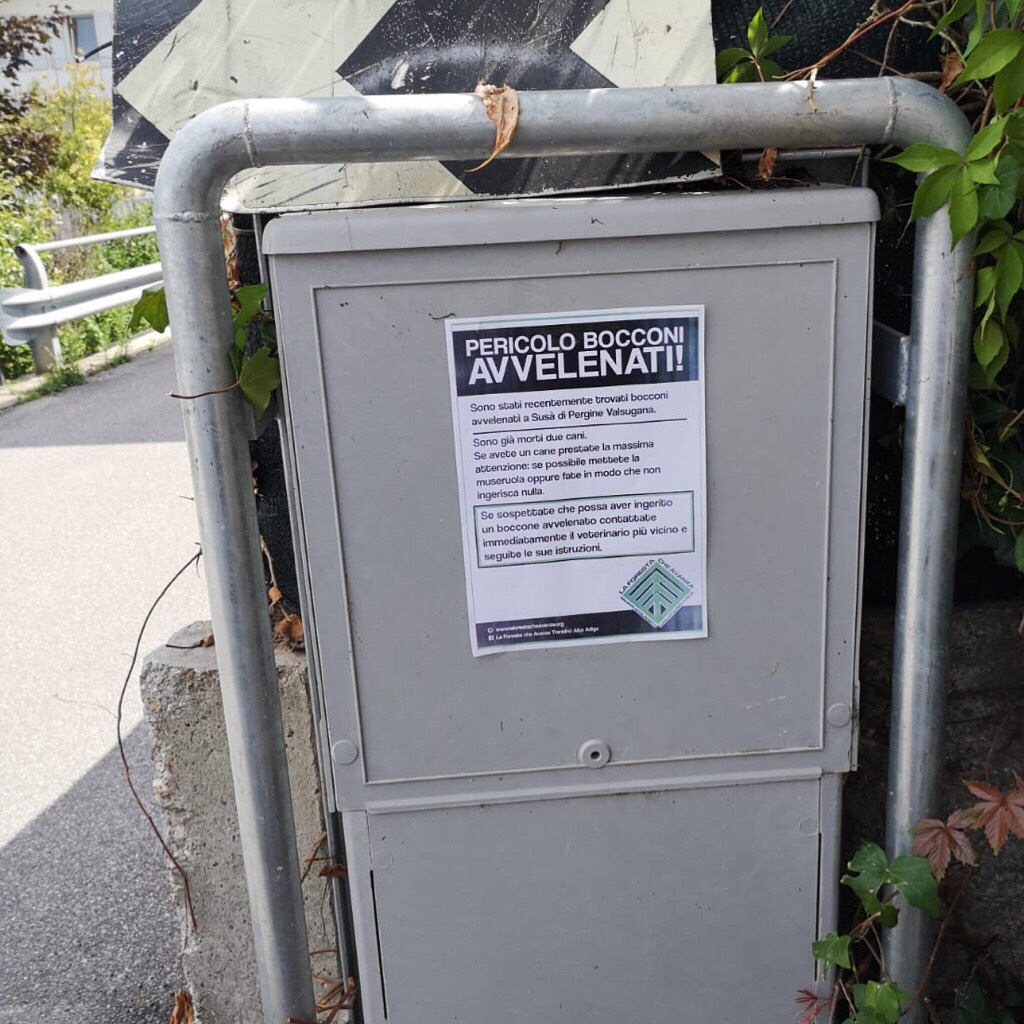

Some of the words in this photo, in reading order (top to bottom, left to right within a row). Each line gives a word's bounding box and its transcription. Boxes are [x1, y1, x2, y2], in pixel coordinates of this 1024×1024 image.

[465, 332, 576, 357] PERICOLO
[583, 326, 684, 349] BOCCONI
[468, 344, 684, 385] AVVELENATI!
[469, 403, 495, 412] Sono
[498, 399, 522, 410] stati
[524, 396, 593, 409] recentemente
[595, 393, 628, 404] trovati
[630, 390, 668, 401] bocconi
[471, 413, 521, 426] avvelenati
[531, 411, 555, 421] Susà
[557, 410, 566, 420] di
[568, 409, 603, 420] Pergine
[605, 406, 656, 417] Valsugana.
[472, 437, 498, 447] Sono
[500, 435, 514, 447] già
[517, 433, 543, 443] morti
[545, 433, 563, 442] due
[565, 430, 587, 440] cani.
[480, 510, 494, 520] Se
[496, 507, 555, 520] sospettate
[557, 504, 575, 514] che
[577, 503, 607, 514] possa
[610, 502, 631, 510] aver
[634, 498, 673, 510] ingerito
[496, 522, 540, 532] boccone
[542, 516, 597, 529] avvelenato
[599, 513, 657, 524] contattate
[484, 550, 522, 562] seguite
[523, 548, 533, 557] le
[535, 548, 553, 556] sue
[555, 542, 602, 557] istruzioni.
